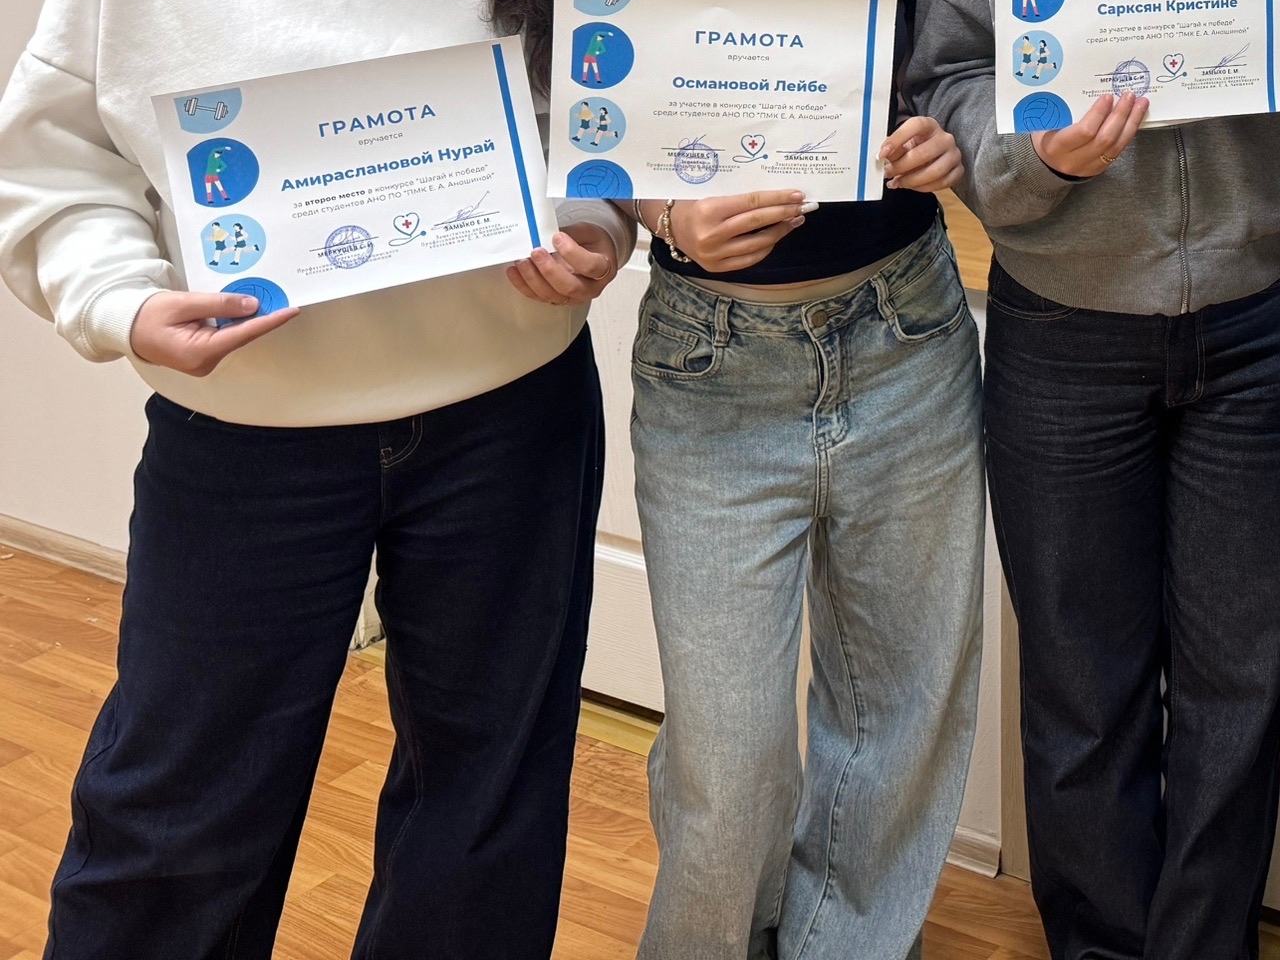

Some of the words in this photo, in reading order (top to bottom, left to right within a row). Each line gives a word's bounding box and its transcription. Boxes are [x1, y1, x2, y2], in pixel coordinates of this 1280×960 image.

[1098, 3, 1161, 17] Сарксян
[1166, 0, 1237, 13] Кристине
[1109, 26, 1136, 34] участие
[1143, 23, 1175, 31] конкурсе
[1177, 21, 1201, 29] "Шагай
[1208, 18, 1235, 26] победе"
[696, 31, 803, 48] ГРАМОТА
[728, 54, 769, 62] вручается
[673, 77, 769, 91] Османовой
[774, 80, 827, 92] Лейбе
[679, 101, 711, 109] участие
[720, 102, 756, 110] конкурсе
[759, 102, 787, 110] "Шагай
[796, 103, 826, 111] победе"
[318, 104, 436, 137] ГРАМОТА
[358, 133, 403, 145] вручается
[281, 151, 433, 191] Амираслановой
[438, 139, 494, 161] Нурай
[294, 201, 302, 209] за
[305, 196, 336, 206] второе
[339, 190, 365, 199] место
[375, 181, 414, 192] конкурсе
[416, 173, 446, 183] "Шагай
[455, 164, 488, 176] победе"
[292, 209, 319, 218] среди
[321, 200, 364, 213] студентов
[367, 195, 386, 204] АНО
[388, 191, 402, 199] ПО
[404, 187, 427, 196] "ПМК
[428, 184, 436, 192] Е.
[448, 173, 494, 187] Аношиной"
